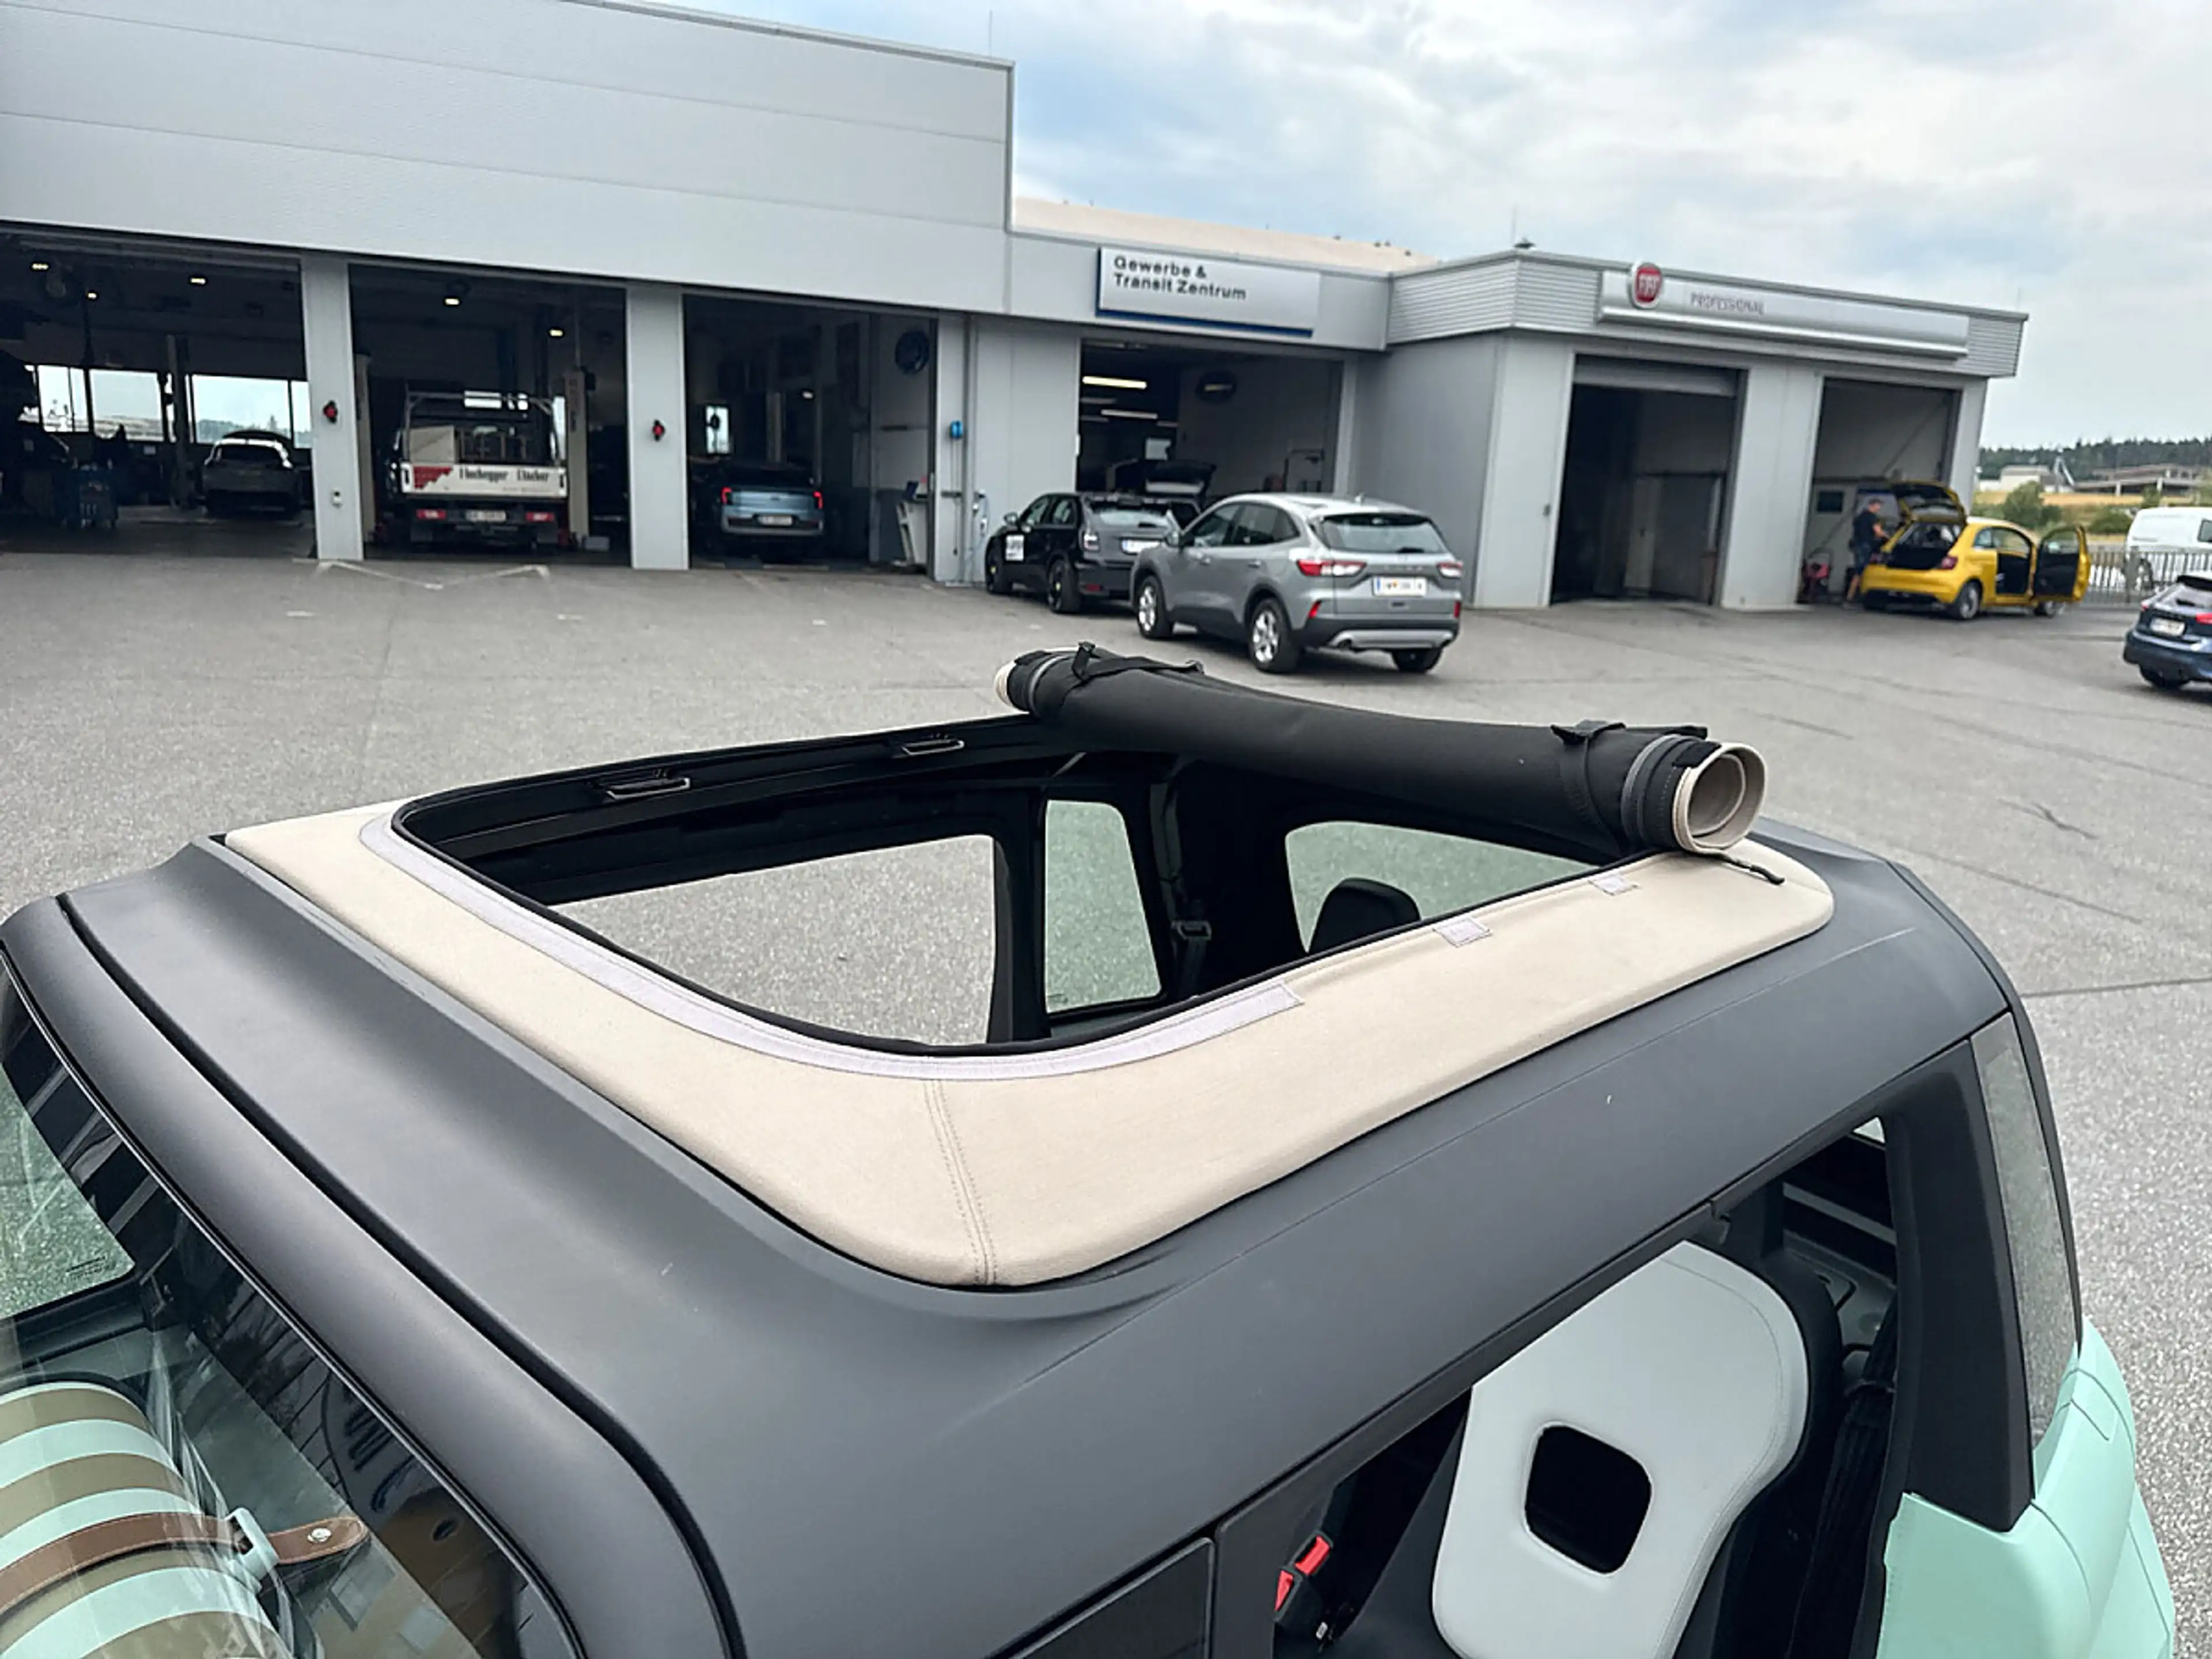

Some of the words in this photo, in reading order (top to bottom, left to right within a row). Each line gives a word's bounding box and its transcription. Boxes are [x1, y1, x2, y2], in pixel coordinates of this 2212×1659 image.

[1114, 256, 1191, 277] Gewerbe
[1195, 265, 1207, 279] &
[1114, 272, 1172, 292] Transit
[1176, 279, 1247, 300] Zentrum
